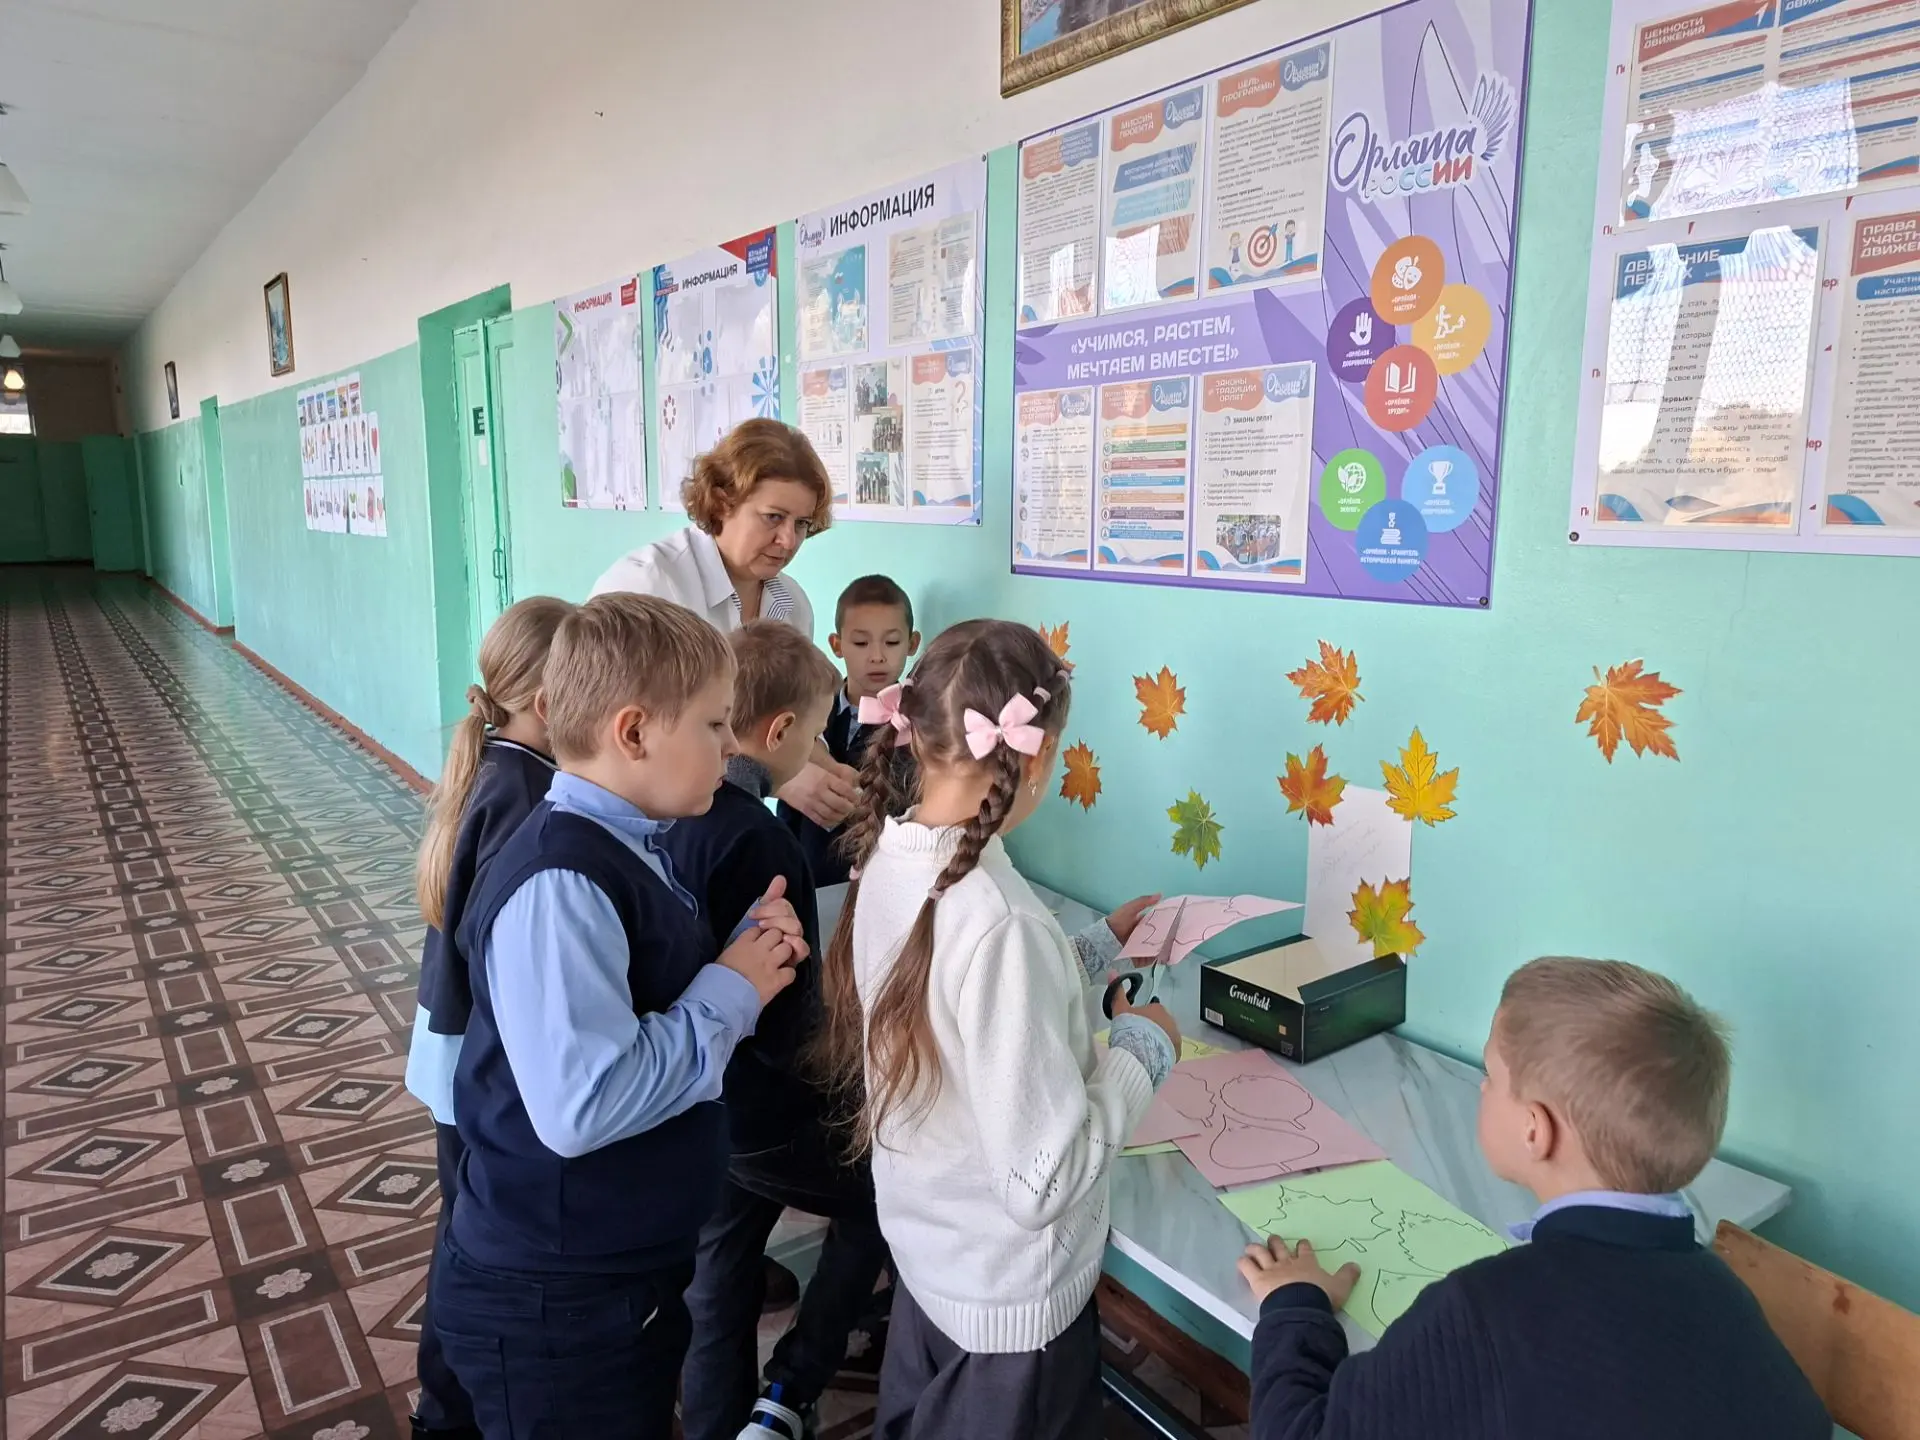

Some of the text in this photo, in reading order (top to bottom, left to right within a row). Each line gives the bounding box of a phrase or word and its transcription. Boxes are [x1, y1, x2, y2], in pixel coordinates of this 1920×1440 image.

[1644, 16, 1704, 41] ЦЕННОСТИ
[1644, 25, 1706, 49] ДВИЖЕНИЯ
[1221, 80, 1276, 103] ПРОГРАММЫ
[1237, 77, 1260, 90] ЦЕЛЬ
[1119, 122, 1154, 138] ПРОЕКТА
[1120, 112, 1153, 129] МИССИЯ
[1334, 112, 1477, 191] Орлята
[830, 183, 935, 238] ИНФОРМАЦИЯ
[1863, 219, 1917, 236] ПРАВА
[682, 263, 738, 290] ИНФОРМАЦИЯ
[574, 292, 613, 314] ИНФОРМАЦИЯ
[1071, 314, 1236, 355] «УЧИМСЯ, РАСТЕМ,
[1067, 343, 1240, 381] МЕЧТАЕМ ВМЕСТЕ!»
[1215, 377, 1247, 388] ЗАКОНЫ
[1216, 384, 1257, 395] ТРАДИЦИИ
[1220, 393, 1244, 402] ОРЛЯТ
[1229, 984, 1269, 1012] Greenfield
